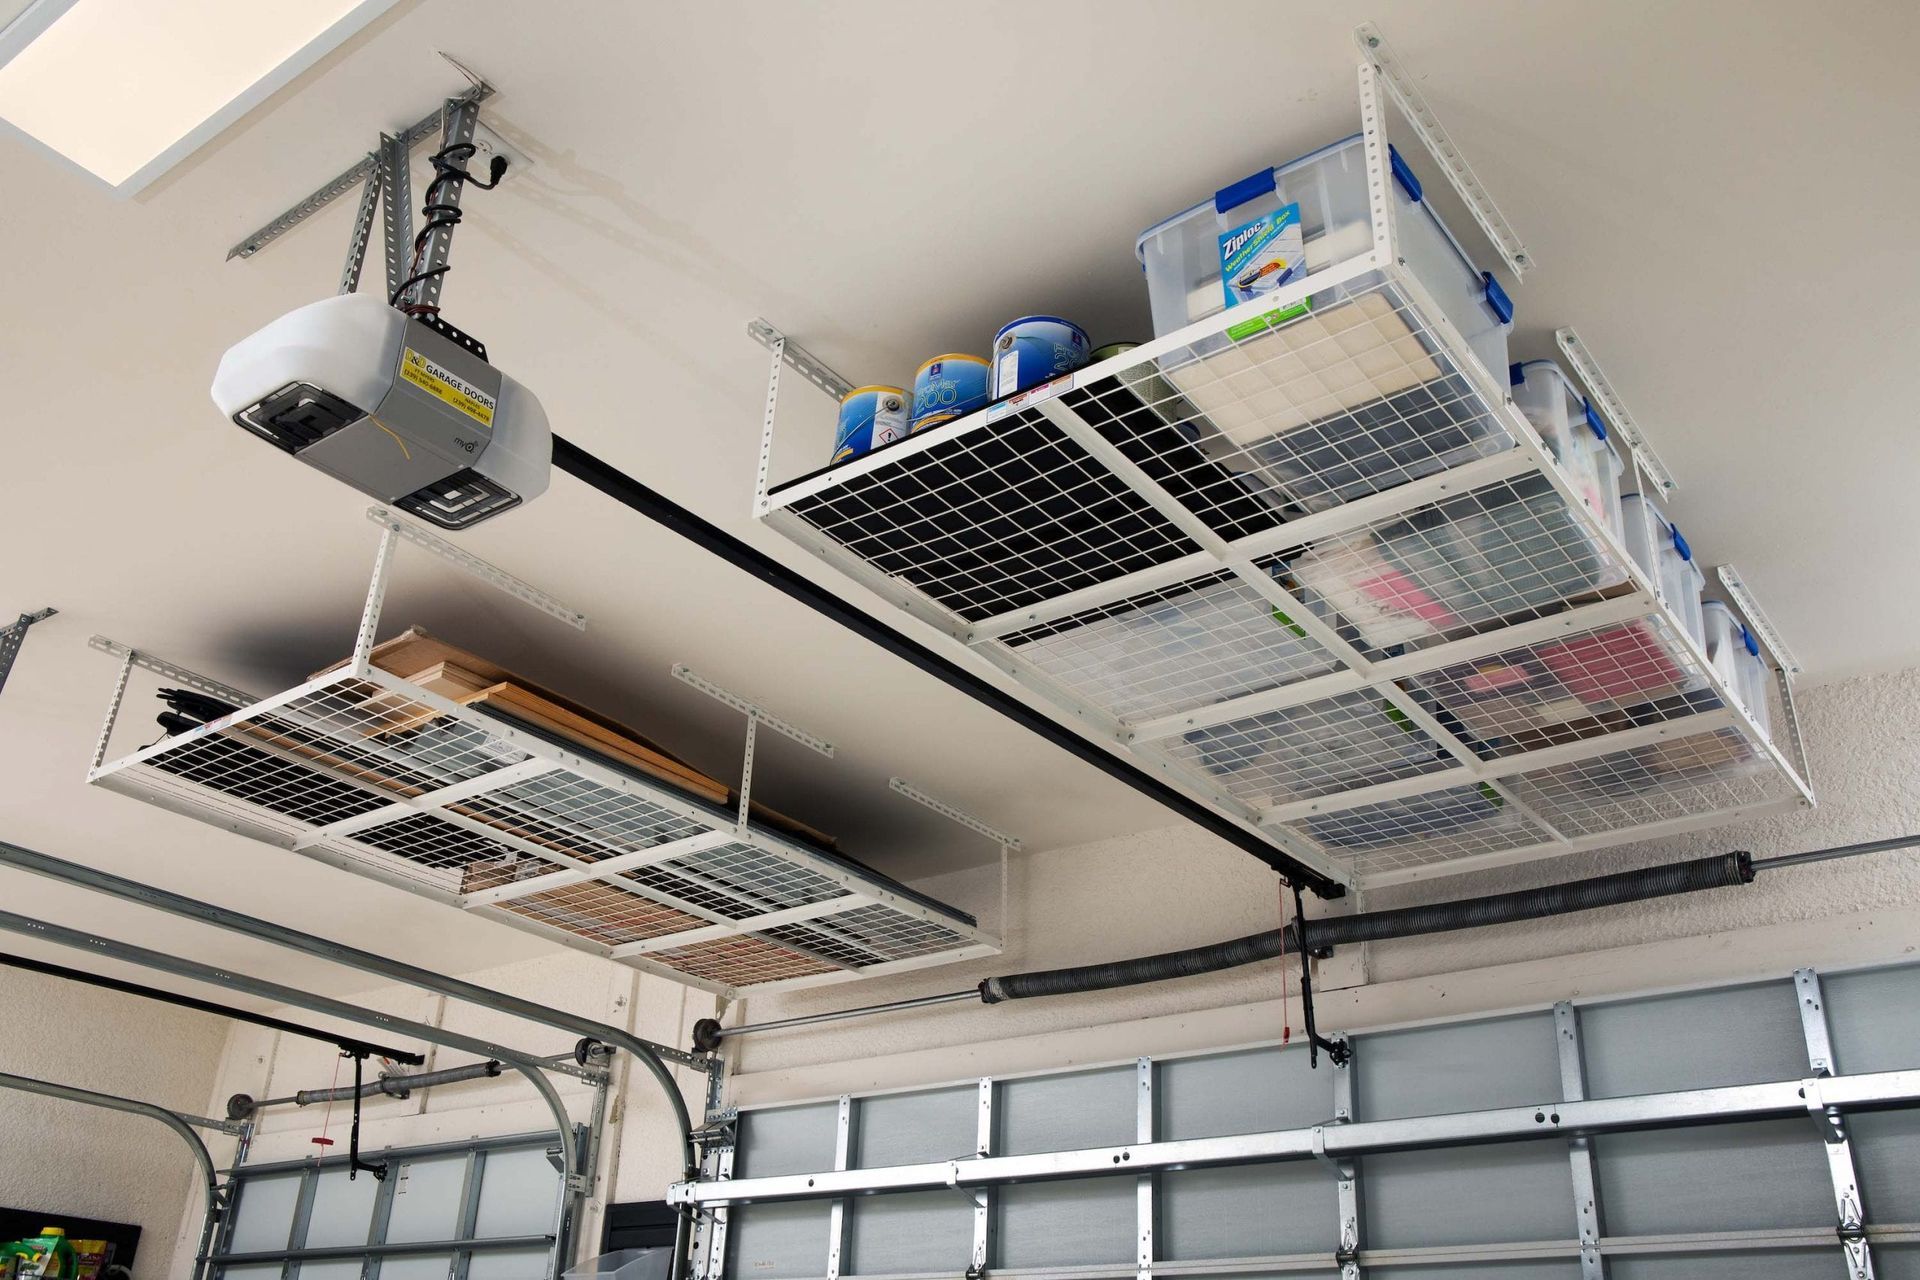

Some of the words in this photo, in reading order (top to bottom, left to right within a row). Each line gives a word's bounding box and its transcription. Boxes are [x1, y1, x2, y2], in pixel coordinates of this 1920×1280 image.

[1223, 222, 1261, 260] Ziploc
[1225, 224, 1274, 272] WeatherShield
[1276, 210, 1291, 225] Box
[426, 365, 462, 391] GARAGE
[464, 387, 494, 410] DOORS
[916, 388, 957, 413] 200
